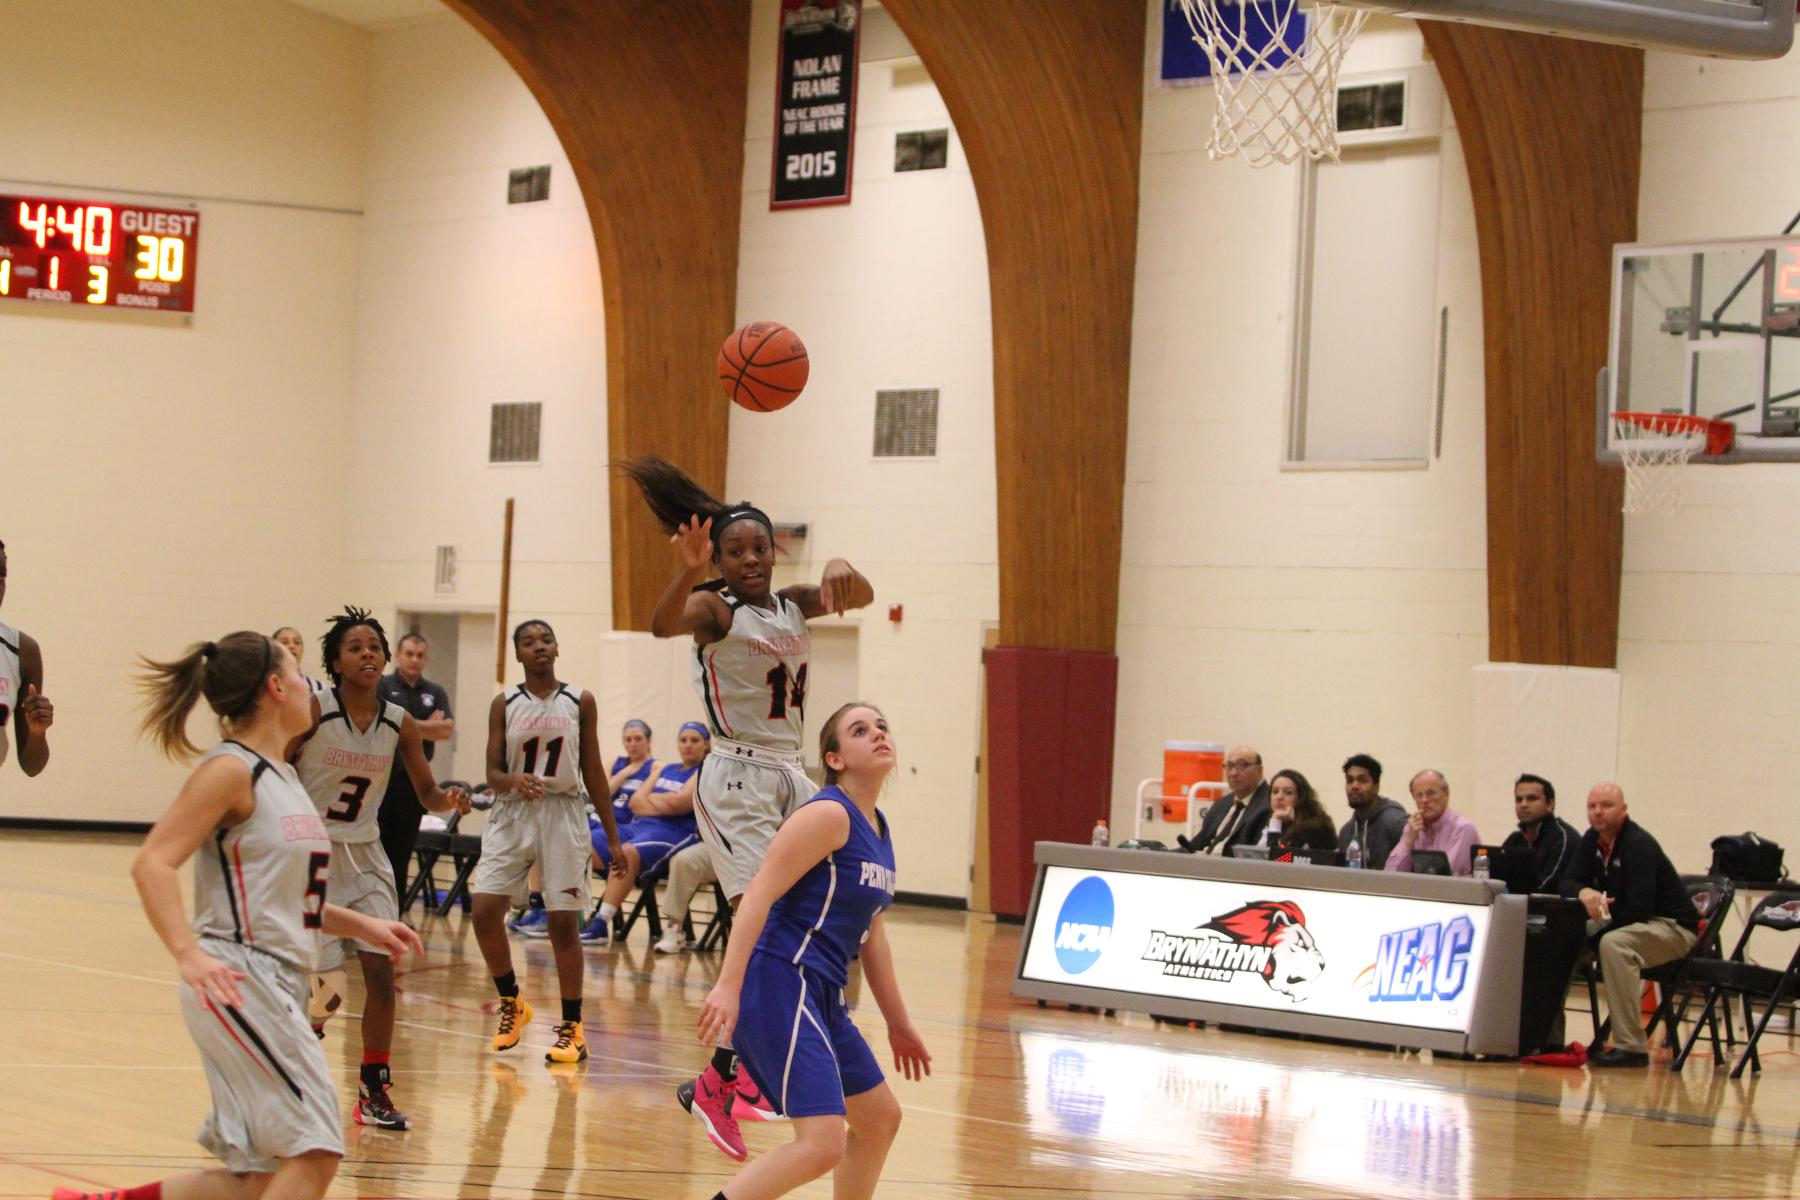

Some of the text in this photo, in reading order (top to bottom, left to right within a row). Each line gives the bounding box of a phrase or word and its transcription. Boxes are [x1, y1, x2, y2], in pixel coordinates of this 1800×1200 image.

[793, 54, 842, 77] NOLAN
[792, 76, 841, 99] FRAME
[783, 116, 844, 136] OF THE YEAR
[786, 150, 837, 179] 2015
[19, 201, 112, 255] 4:40
[120, 210, 196, 236] GUEST
[49, 256, 59, 291] 1
[135, 235, 184, 282] 30
[27, 287, 71, 302] PERIOD
[87, 265, 108, 304] 3
[116, 293, 159, 308] BONUS
[766, 661, 808, 720] 14
[522, 735, 564, 777] 11
[326, 774, 372, 822] 3
[303, 851, 330, 929] 5
[1056, 922, 1112, 951] NCAA
[1163, 963, 1235, 982] ATHLETICS
[1369, 915, 1475, 1002] NEAC
